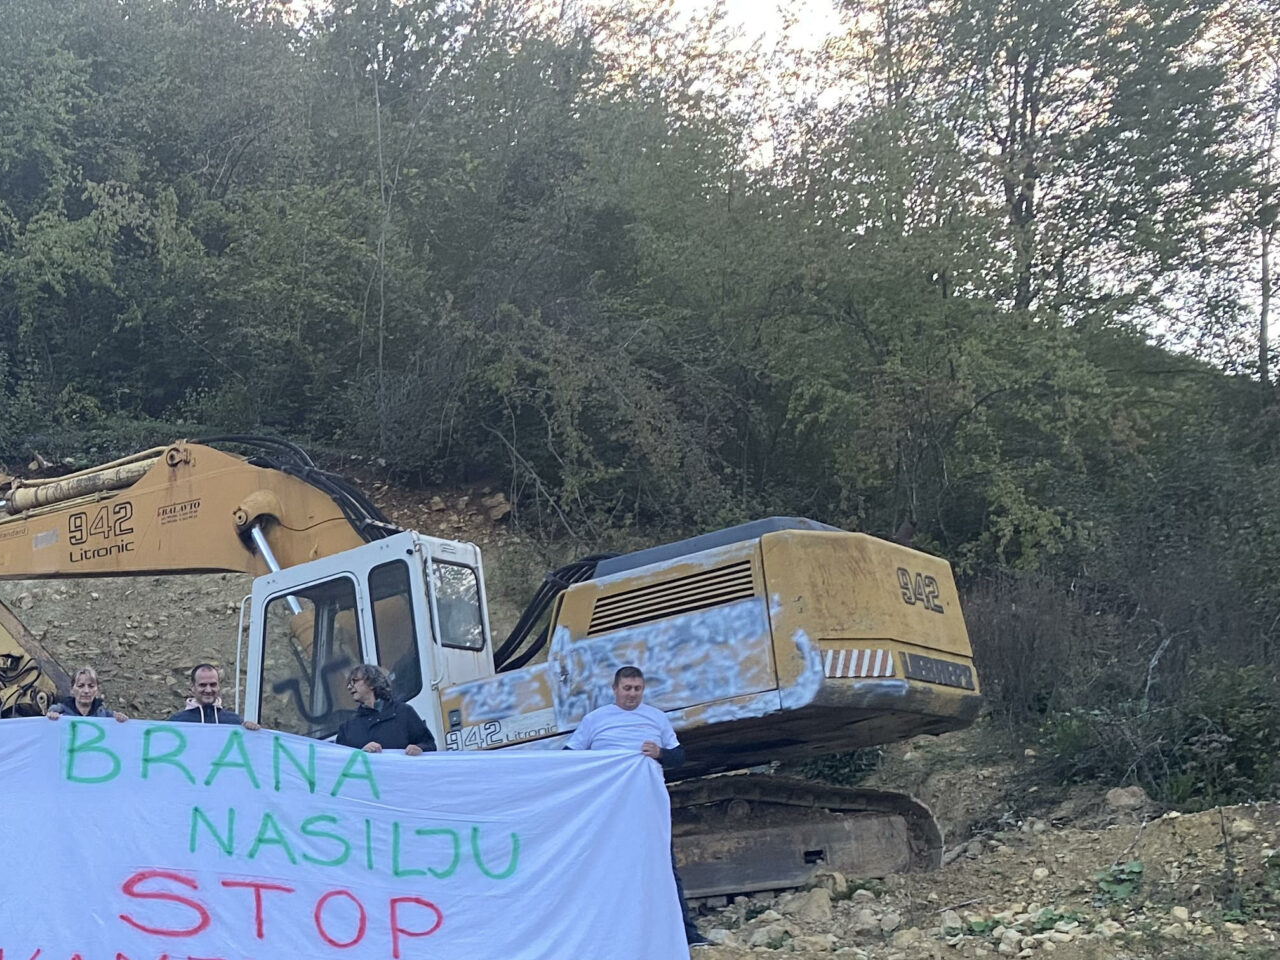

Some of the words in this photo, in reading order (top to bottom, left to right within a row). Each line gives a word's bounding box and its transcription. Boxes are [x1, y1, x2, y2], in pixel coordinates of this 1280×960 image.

[69, 501, 134, 546] 942
[70, 540, 134, 563] Litronic
[897, 567, 944, 614] 942
[445, 720, 504, 751] 942
[66, 720, 380, 799] BRANA
[189, 806, 520, 879] NASILJU
[119, 869, 443, 959] STOP
